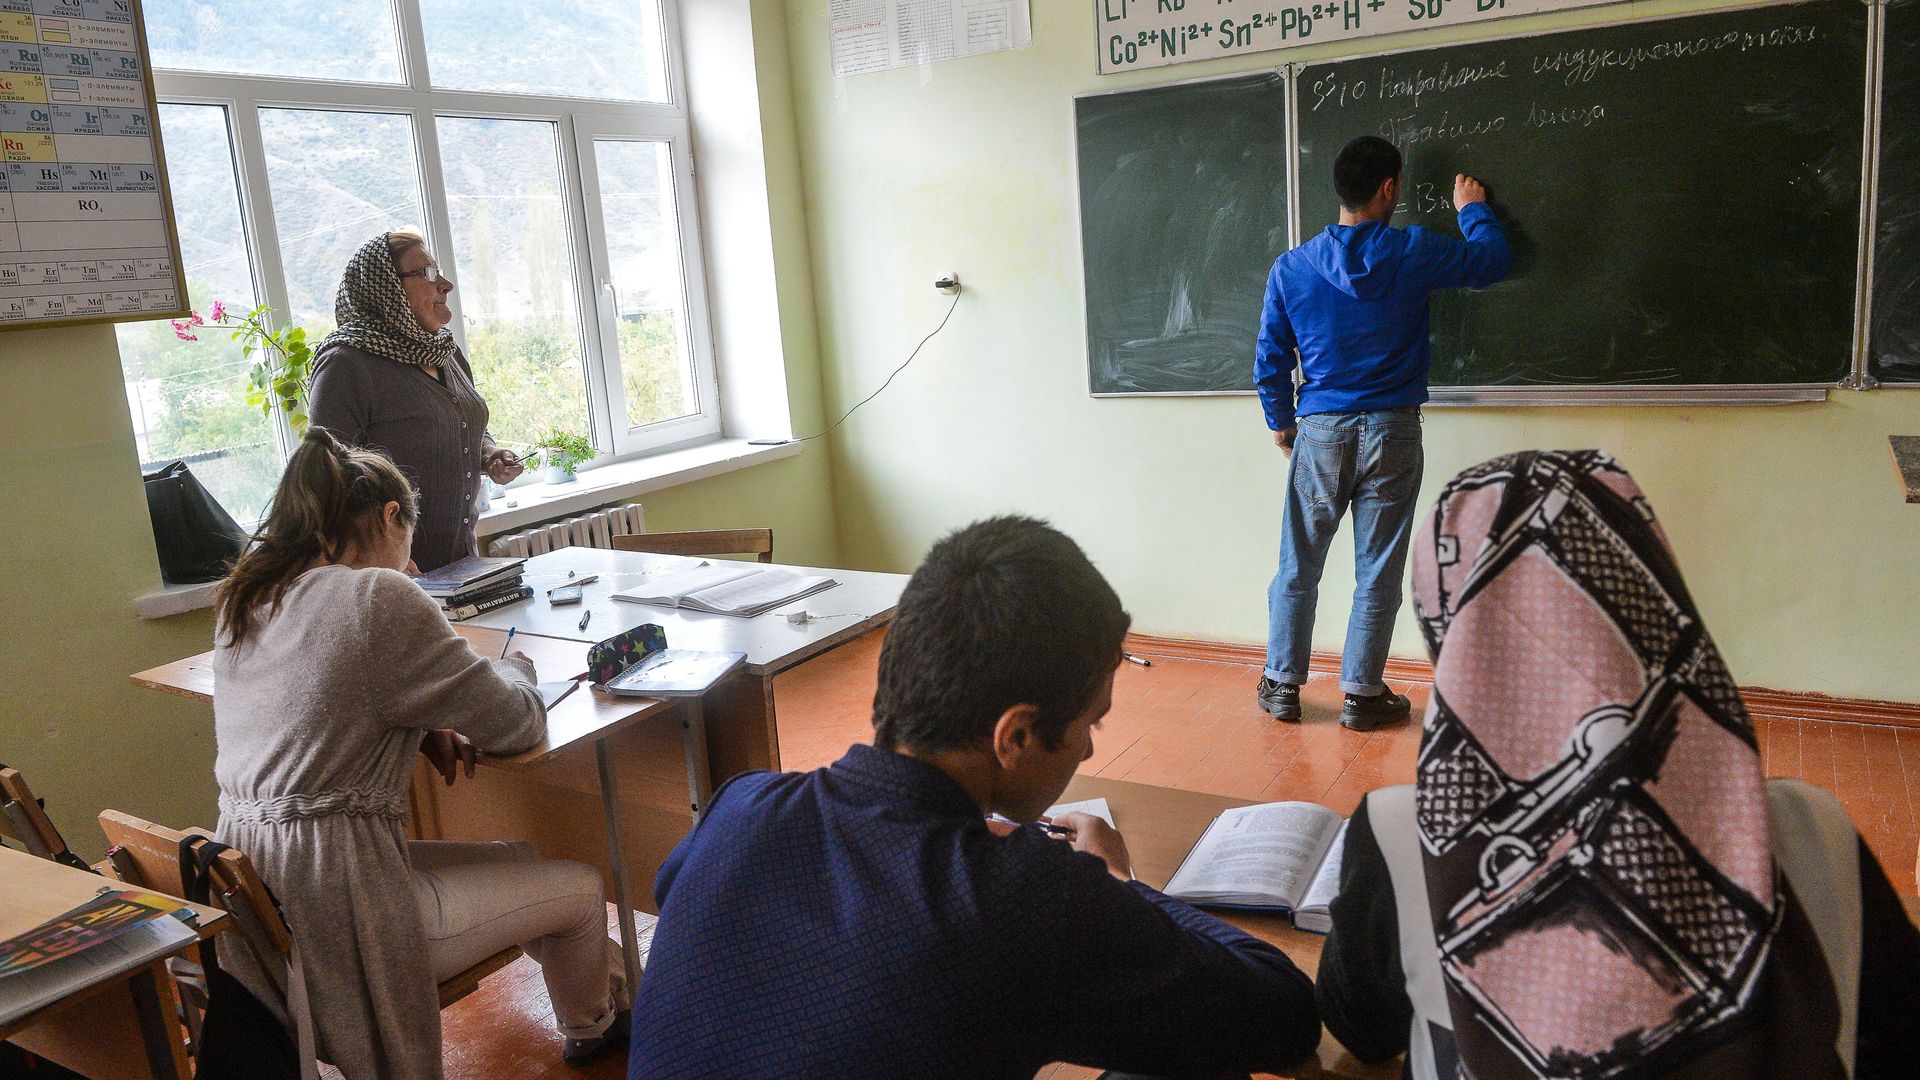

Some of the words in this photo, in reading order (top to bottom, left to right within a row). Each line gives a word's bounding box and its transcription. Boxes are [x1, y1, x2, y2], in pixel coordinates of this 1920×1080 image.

[114, 0, 128, 12] Ni
[18, 49, 39, 62] Ru
[70, 52, 90, 66] Rh
[120, 56, 138, 69] Pd
[30, 109, 49, 122] Os
[85, 111, 98, 124] Ir
[131, 114, 146, 126] Pt
[4, 138, 24, 151] Rn
[40, 168, 59, 180] Hs
[89, 169, 109, 181] Mt
[139, 170, 154, 182] Ds
[2, 269, 16, 278] Ho
[45, 267, 57, 276] Er
[10, 302, 22, 312] Es
[477, 592, 520, 611] МАТЕМАТИКА
